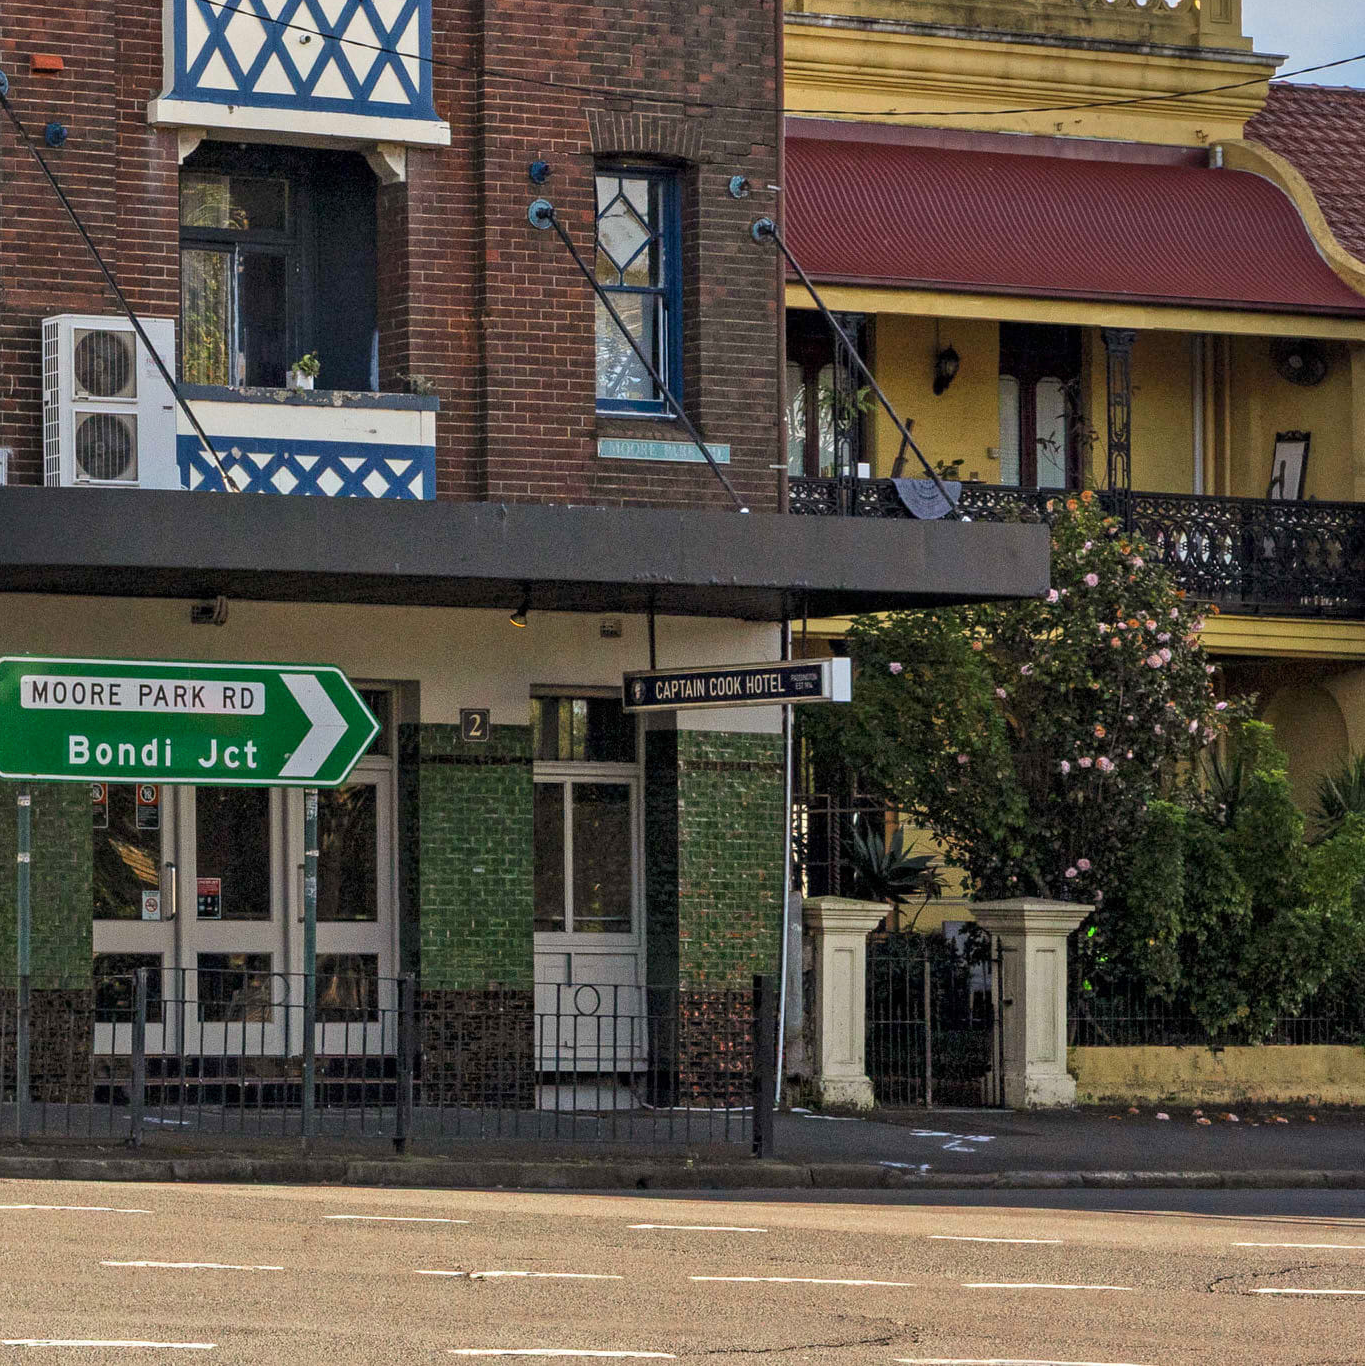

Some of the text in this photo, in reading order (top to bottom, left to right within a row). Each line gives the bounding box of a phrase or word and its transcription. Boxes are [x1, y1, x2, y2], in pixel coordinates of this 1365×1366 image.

[31, 680, 254, 711] MOORE PARK RD
[655, 673, 786, 699] CAPTAIN COOK HOTEL
[469, 714, 483, 736] 2
[69, 735, 258, 769] Bondi Jct
